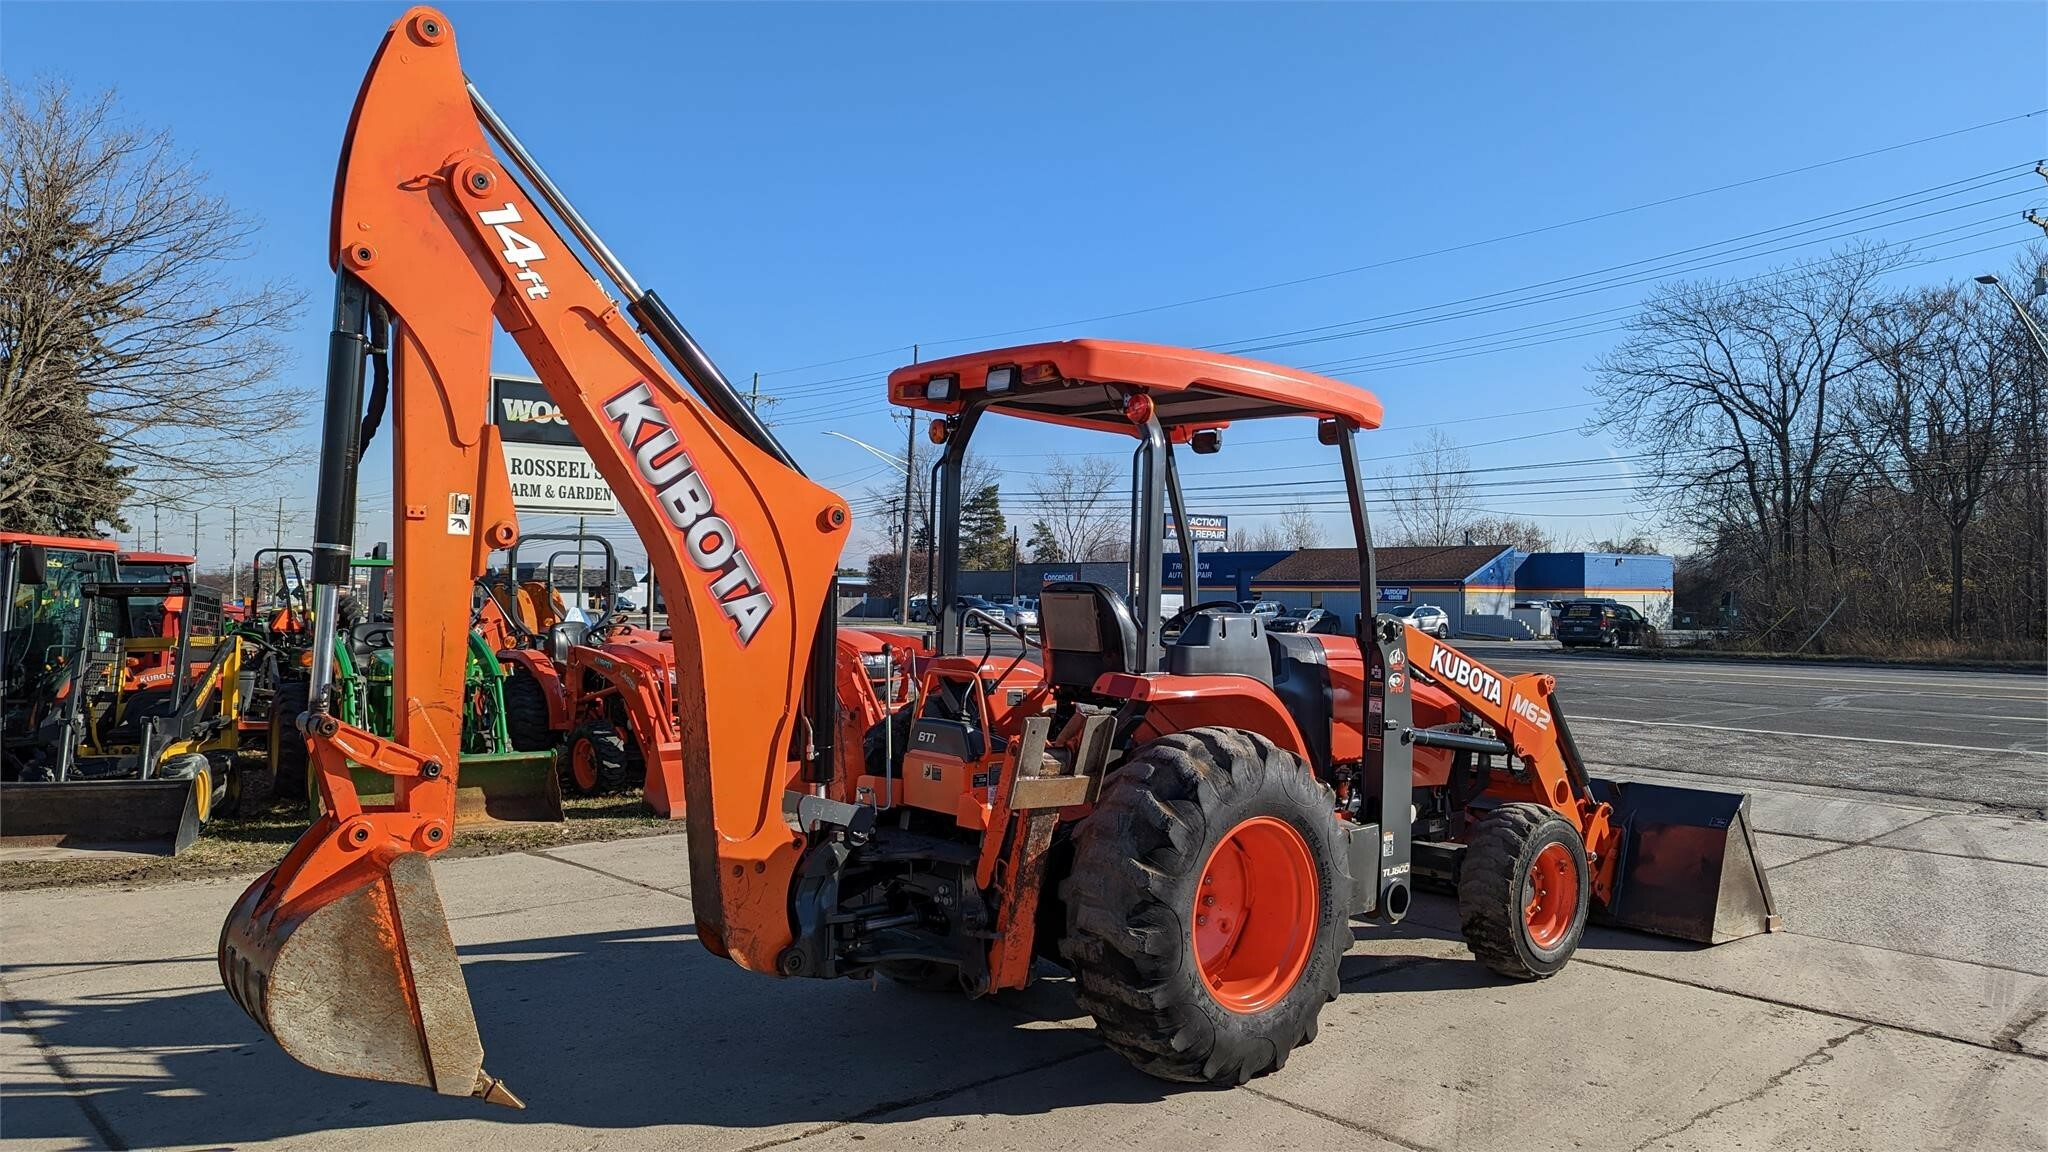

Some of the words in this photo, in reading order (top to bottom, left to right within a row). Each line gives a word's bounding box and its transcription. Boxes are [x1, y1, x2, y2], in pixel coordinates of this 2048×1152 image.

[502, 398, 569, 425] WOO
[511, 483, 541, 498] ARM
[545, 485, 555, 498] &
[558, 485, 612, 501] GARDEN
[603, 382, 773, 645] KUBOTA
[1188, 517, 1221, 526] -ACTION
[1196, 530, 1225, 539] REPAIR
[1430, 644, 1502, 706] KUBOTA
[1512, 692, 1551, 731] M62
